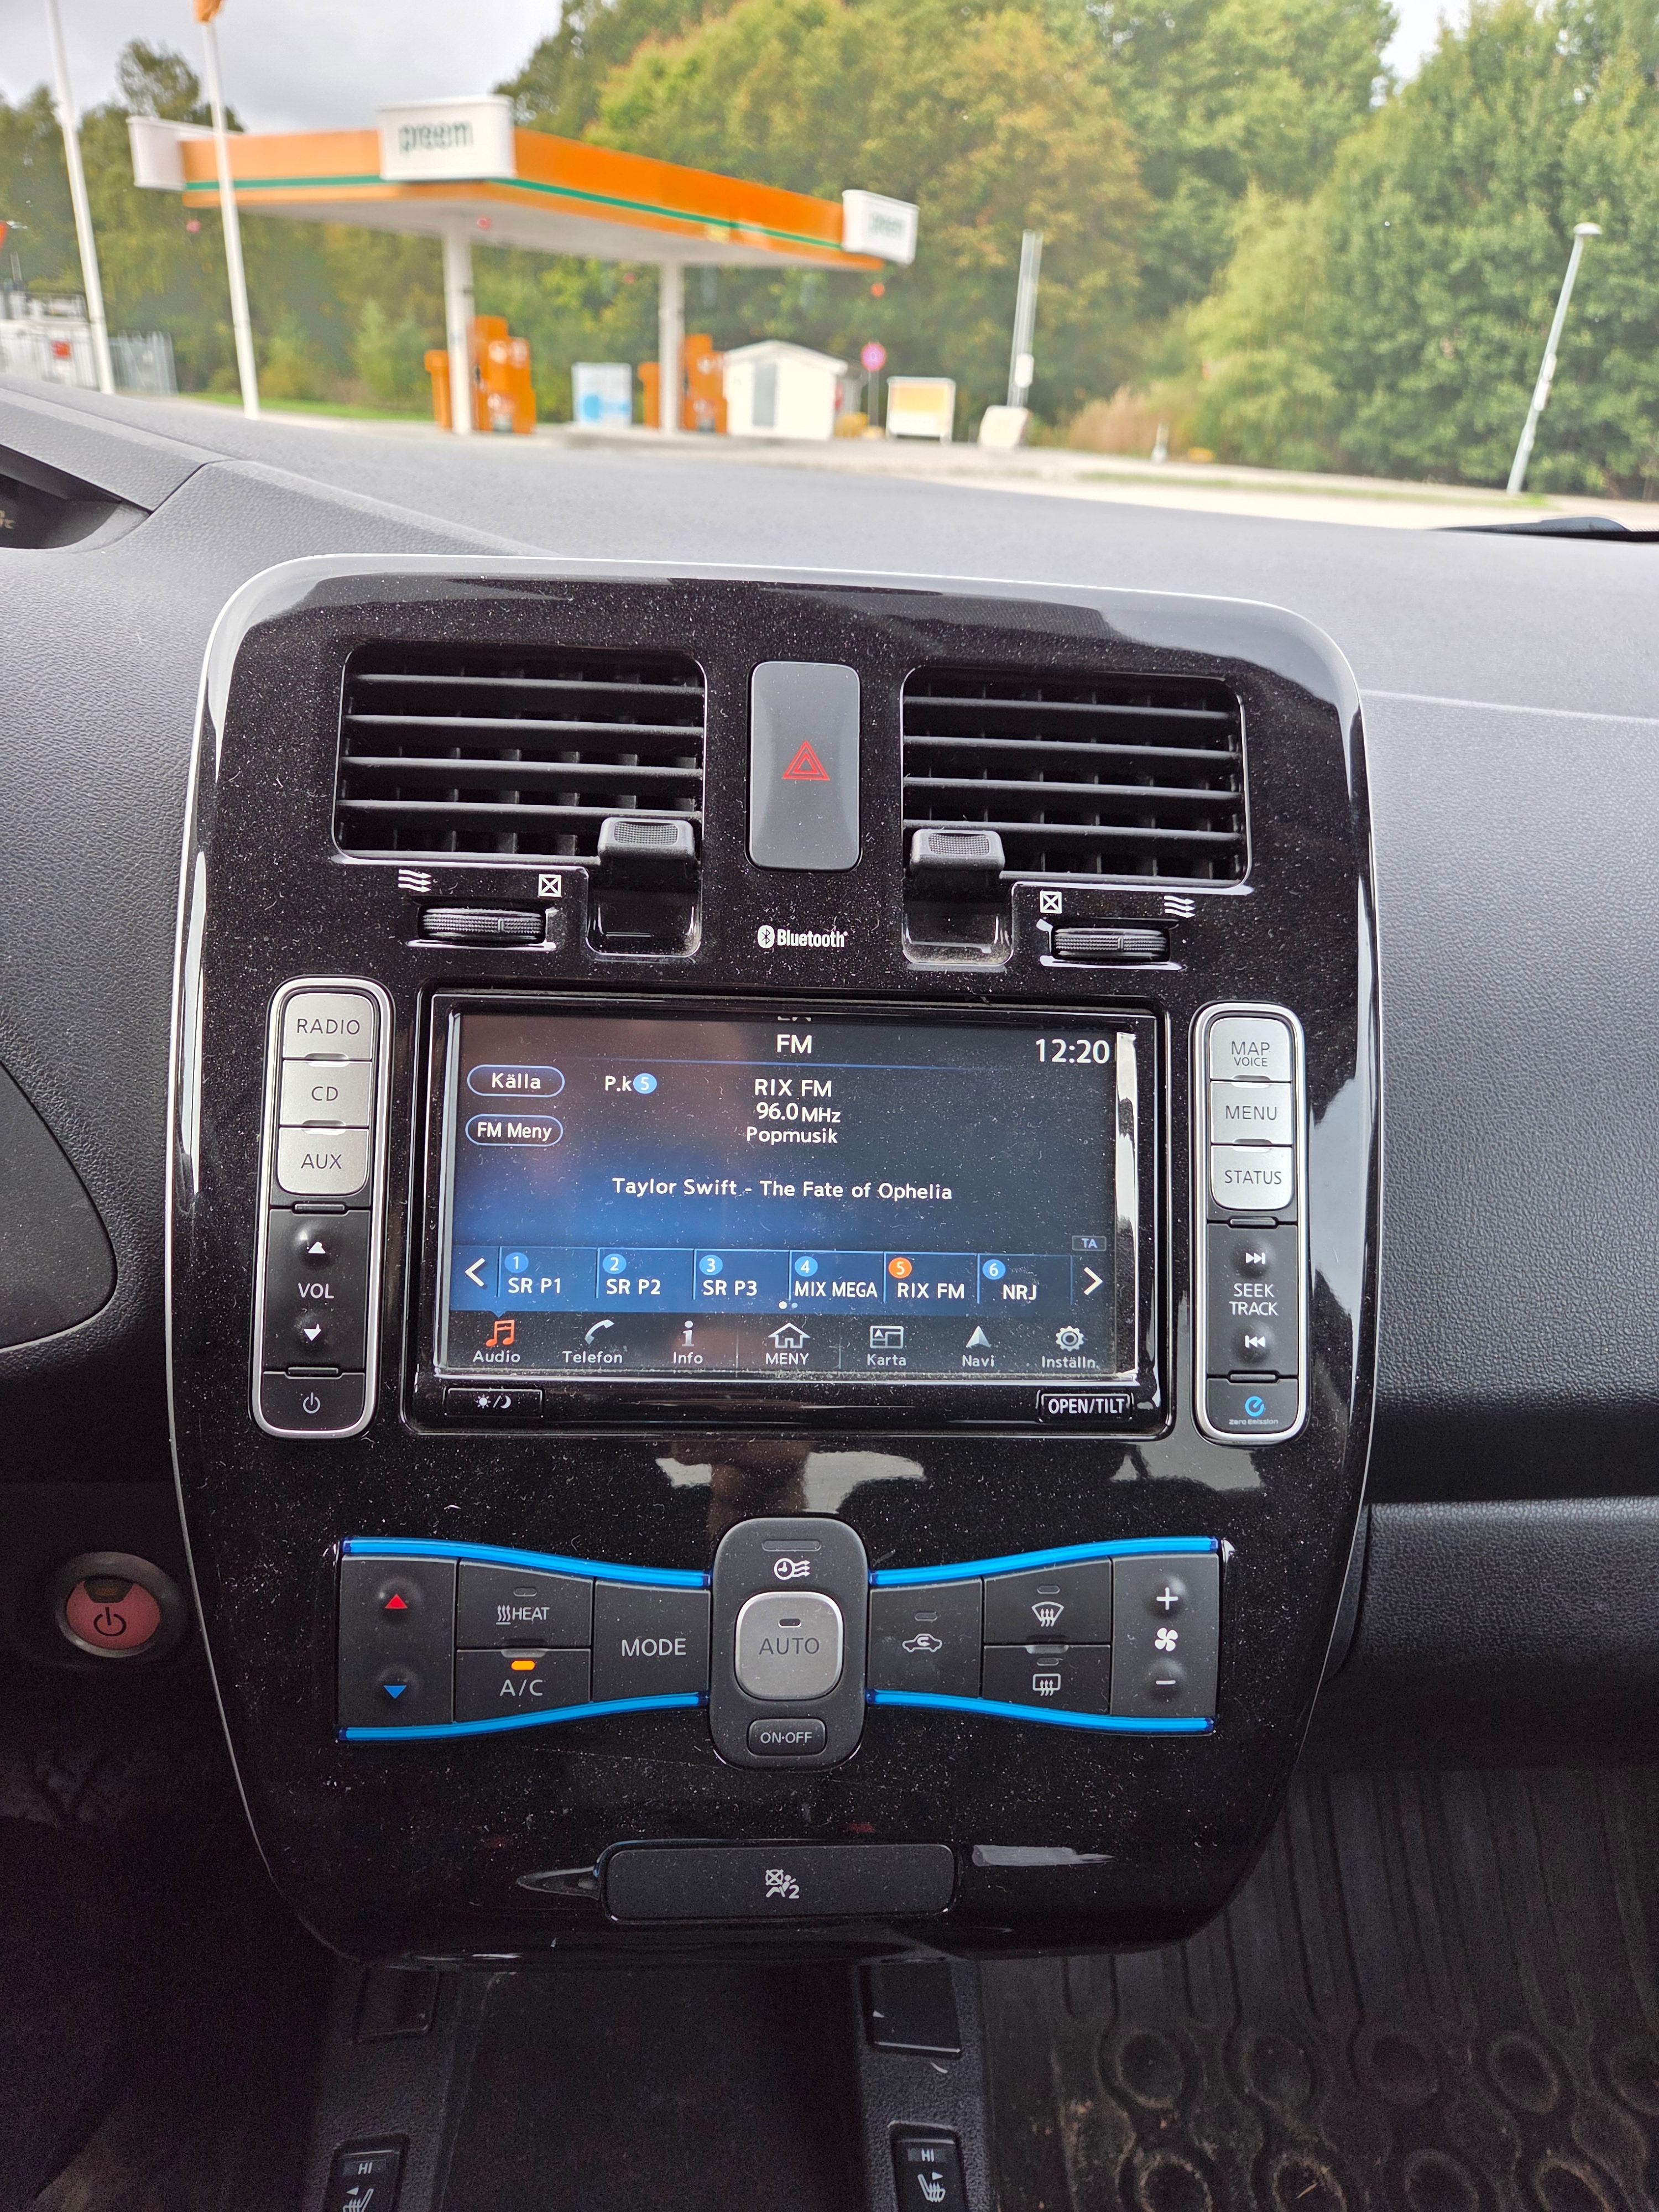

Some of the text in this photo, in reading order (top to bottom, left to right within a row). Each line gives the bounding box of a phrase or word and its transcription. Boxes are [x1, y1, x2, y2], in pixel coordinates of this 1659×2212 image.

[777, 929, 845, 948] Bluetooth
[296, 1019, 361, 1035] RADIO
[777, 1034, 812, 1054] FM
[1035, 1039, 1110, 1063] 12:20
[1232, 1041, 1270, 1056] MAP
[1234, 1057, 1268, 1067] VOICE
[492, 1072, 541, 1089] Källa
[605, 1076, 650, 1092] P.k 5
[755, 1078, 832, 1097] RIX FM
[311, 1087, 338, 1101] CD
[758, 1102, 841, 1123] 96.0 MHz
[1225, 1105, 1277, 1120] MENU
[477, 1121, 552, 1141] FM Meny
[747, 1126, 838, 1145] Popmusik
[301, 1154, 342, 1169] AUX
[1224, 1170, 1282, 1185] STATUS
[612, 1177, 677, 1197] Taylor
[684, 1178, 737, 1196] Swift
[760, 1181, 795, 1197] The
[803, 1181, 843, 1198] Fate
[852, 1182, 871, 1199] of
[879, 1182, 952, 1202] Ophelia
[1081, 1238, 1098, 1249] TA
[513, 1256, 519, 1270] 1
[610, 1258, 619, 1271] 2
[706, 1259, 715, 1272] 3
[800, 1260, 810, 1273] 4
[896, 1261, 905, 1275] 5
[989, 1263, 998, 1276] 6
[298, 1283, 334, 1299] VOL
[508, 1277, 561, 1293] SR P1
[606, 1279, 661, 1295] SR P2
[702, 1280, 757, 1296] SR P3
[795, 1281, 878, 1297] MIX MEGA
[898, 1282, 964, 1299] RIX FM
[1003, 1284, 1037, 1301] NRJ
[1233, 1283, 1274, 1297] SEEK
[1229, 1301, 1279, 1316] TRACK
[473, 1350, 520, 1364] Audio
[562, 1351, 623, 1364] Telefon
[672, 1352, 703, 1364] Info
[765, 1353, 809, 1365] MENY
[867, 1353, 906, 1366] Karta
[962, 1354, 995, 1367] Navi
[1042, 1355, 1099, 1369] Inställn.
[1048, 1397, 1125, 1414] OPEN/TILT
[512, 1607, 550, 1620] HEAT
[621, 1639, 686, 1656] MODE
[759, 1637, 820, 1656] AUTO
[499, 1679, 543, 1697] A/C
[922, 2150, 935, 2162] HI
[358, 2162, 373, 2174] HI
